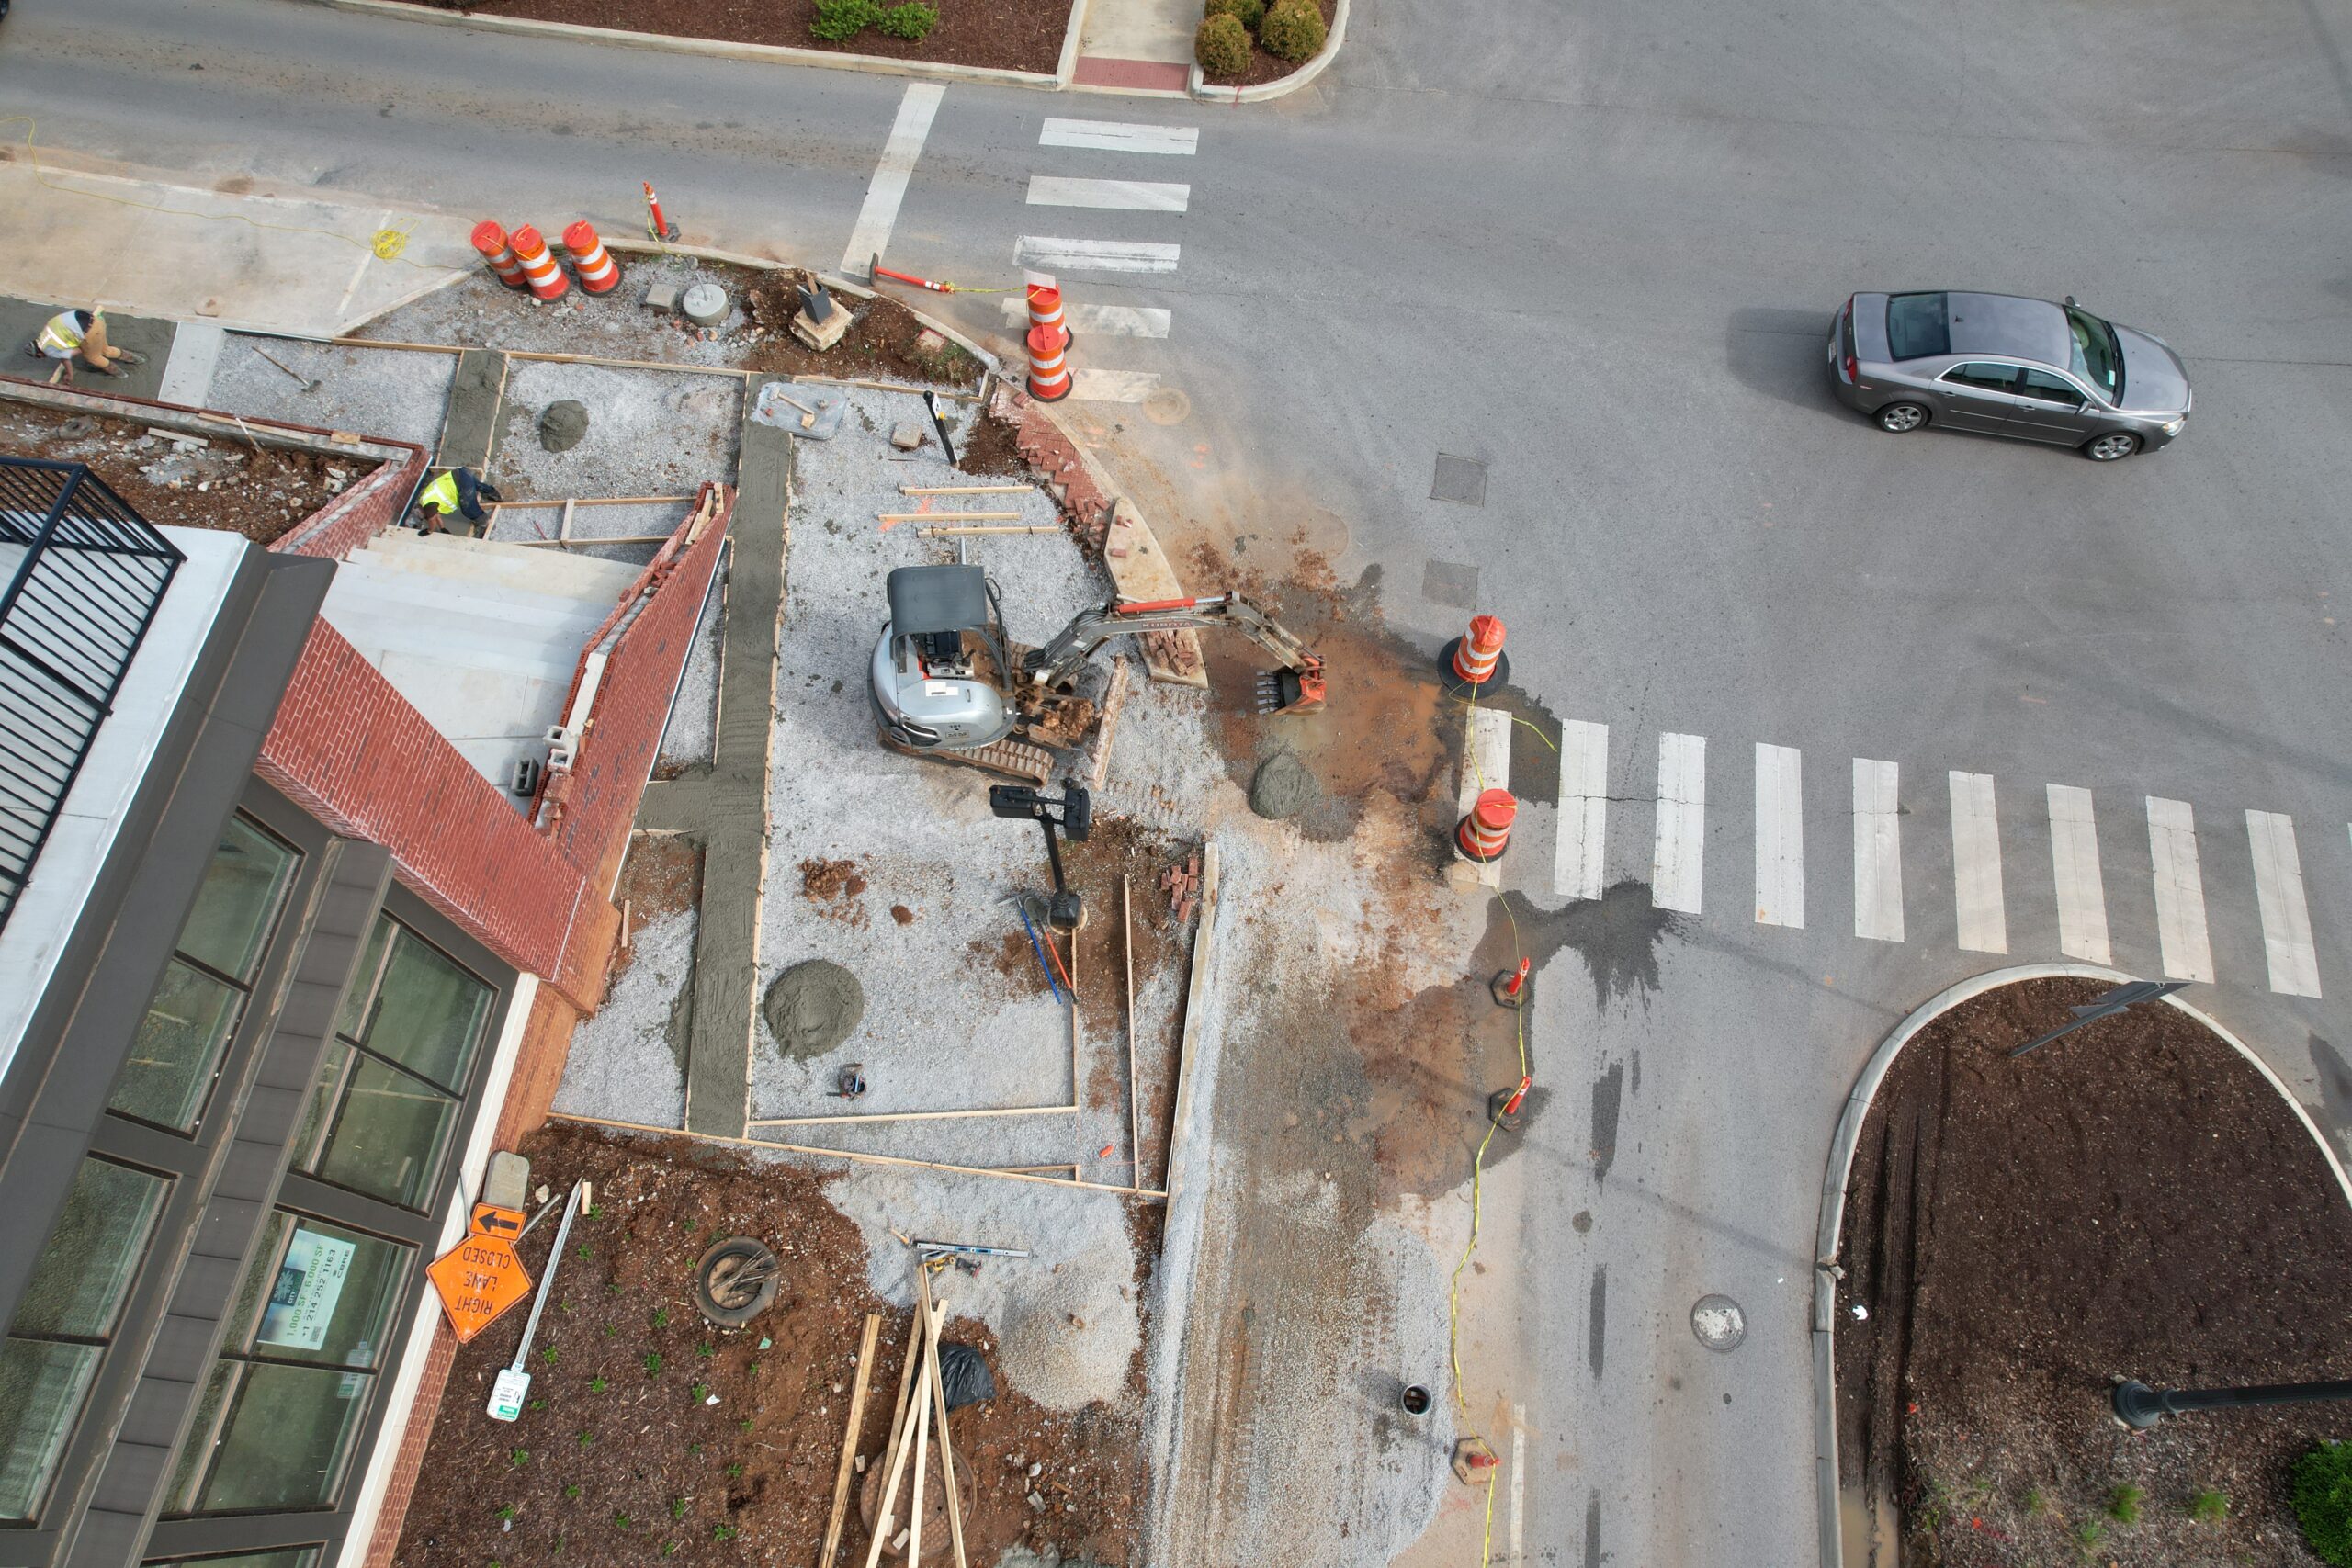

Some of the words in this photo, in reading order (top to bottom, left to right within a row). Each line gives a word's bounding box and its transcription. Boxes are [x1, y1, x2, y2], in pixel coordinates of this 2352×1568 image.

[462, 1246, 511, 1269] CLOSED
[286, 1309, 302, 1336] 1,000
[297, 1293, 306, 1306] SF
[304, 1258, 320, 1287] 6,000
[315, 1243, 323, 1257] SF
[306, 1302, 318, 1321] 214
[314, 1278, 325, 1298] 252
[322, 1249, 336, 1273] 1163
[463, 1270, 498, 1292] LANE
[288, 1291, 296, 1304] CITY
[454, 1295, 493, 1316] RIGHT
